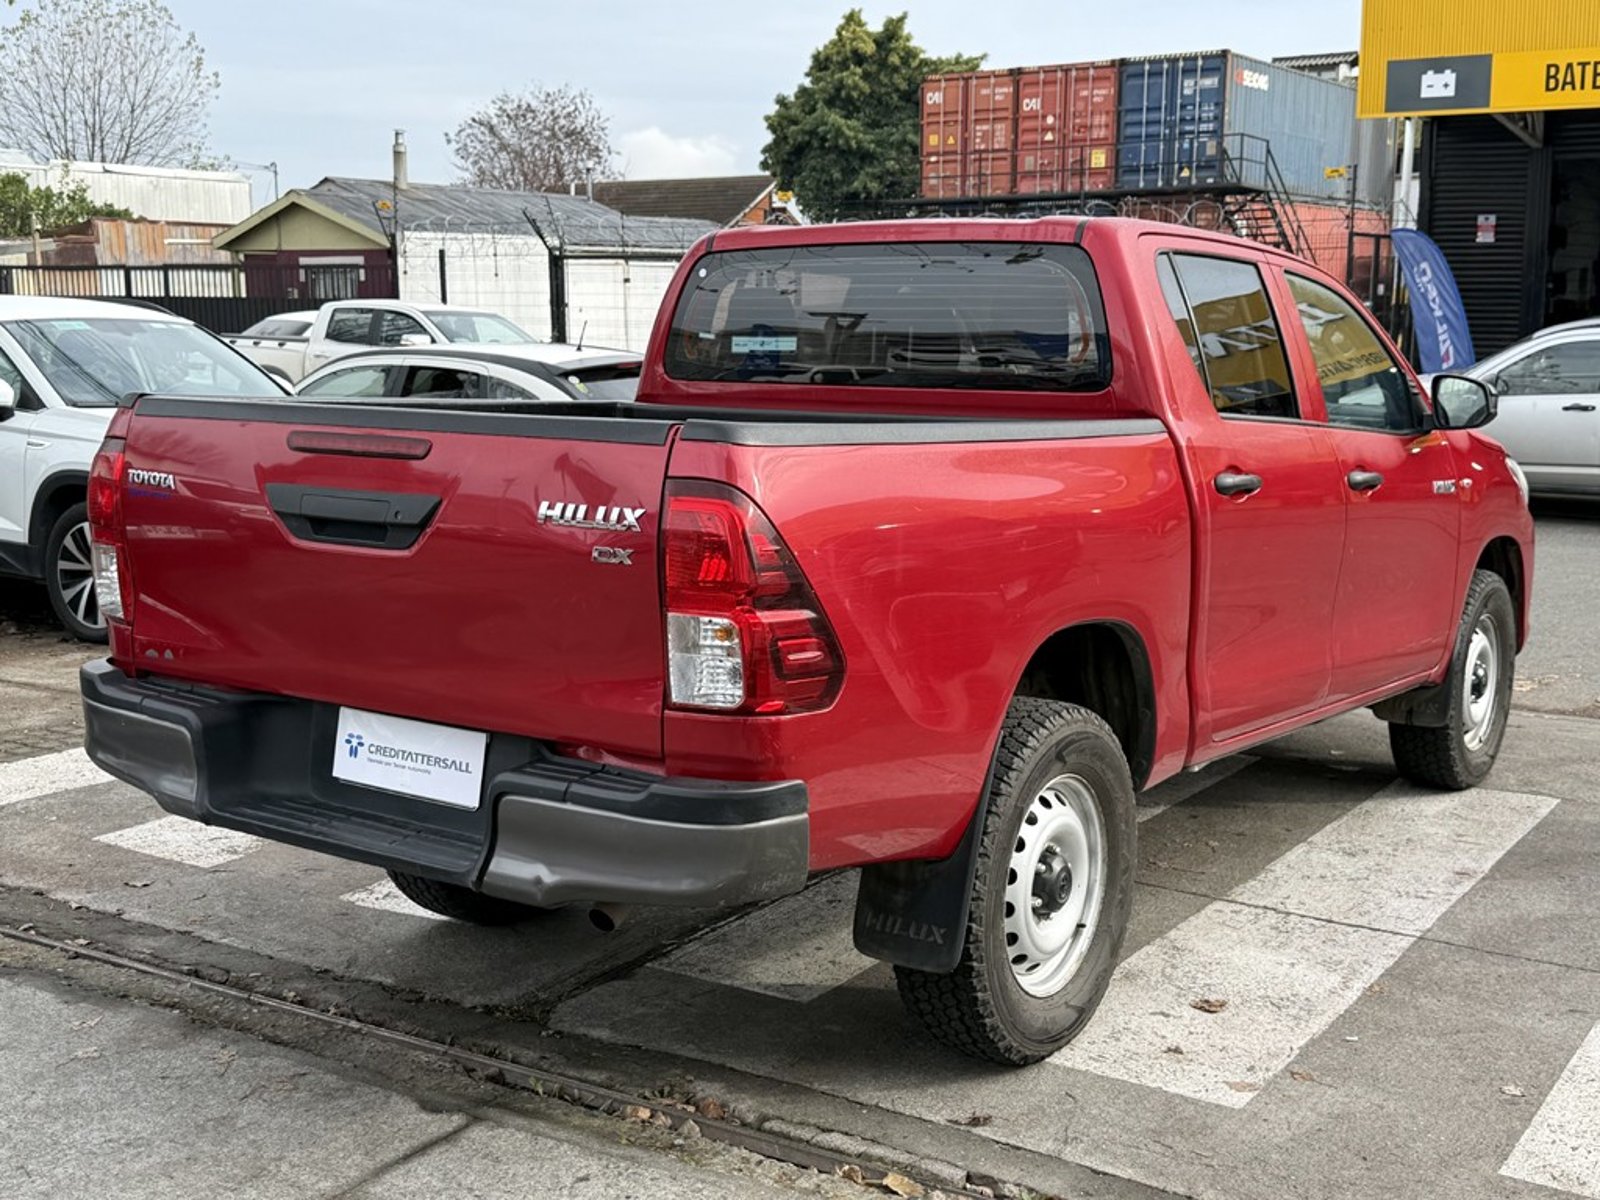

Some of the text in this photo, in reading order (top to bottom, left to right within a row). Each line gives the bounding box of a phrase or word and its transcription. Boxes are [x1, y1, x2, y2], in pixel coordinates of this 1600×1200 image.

[1545, 60, 1600, 92] BATE
[127, 468, 175, 490] TOYOTA
[537, 500, 646, 532] HILUX
[591, 545, 634, 565] DX
[367, 743, 473, 774] CREDITATTERSALL
[864, 911, 947, 944] HILUX
